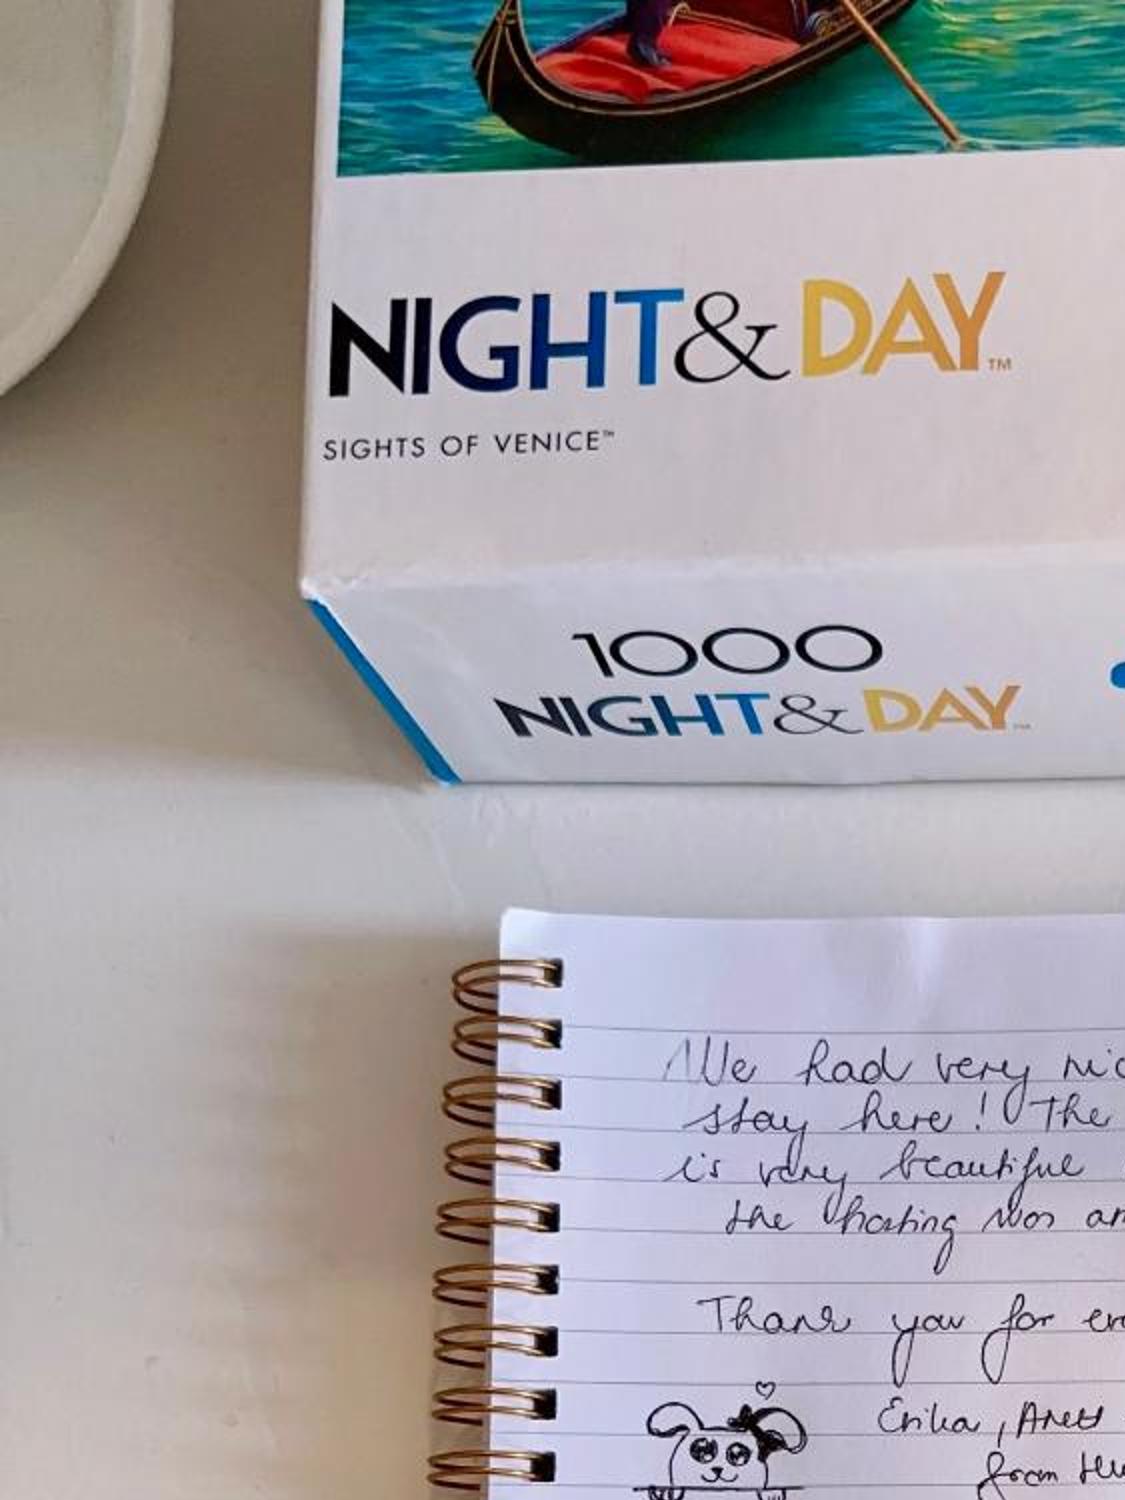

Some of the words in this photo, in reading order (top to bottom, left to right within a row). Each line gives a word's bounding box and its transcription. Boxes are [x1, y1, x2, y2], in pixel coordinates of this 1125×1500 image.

[322, 436, 426, 461] SIGHTS
[440, 434, 480, 458] OF
[571, 625, 883, 678] 1000
[796, 1039, 913, 1086] had
[938, 1052, 1030, 1125] very
[682, 1097, 808, 1176] stay
[1029, 1093, 1112, 1132] The
[662, 1153, 720, 1182] is
[760, 1160, 848, 1225] very
[880, 1140, 1084, 1212] beautiful
[725, 1200, 794, 1234] the
[834, 1195, 957, 1275] hosting
[982, 1206, 1054, 1233] was
[698, 1295, 851, 1333] Thank
[891, 1314, 963, 1387] you
[982, 1294, 1056, 1384] for
